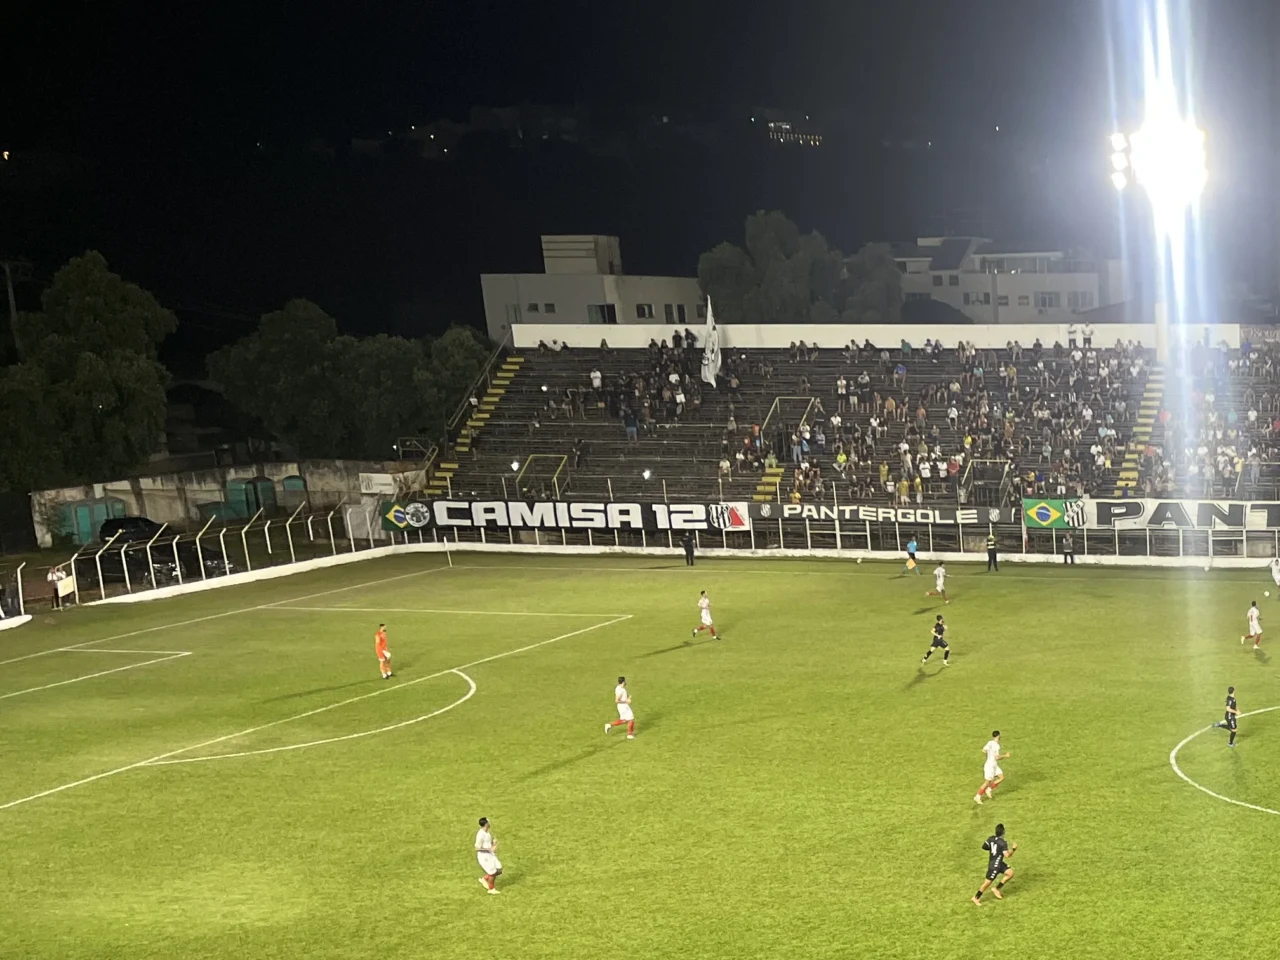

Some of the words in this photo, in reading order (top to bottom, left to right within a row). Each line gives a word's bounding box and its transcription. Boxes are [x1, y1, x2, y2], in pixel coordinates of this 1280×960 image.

[433, 501, 643, 529] CAMISA
[653, 504, 708, 530] 12
[782, 504, 979, 524] PANTERGOLE
